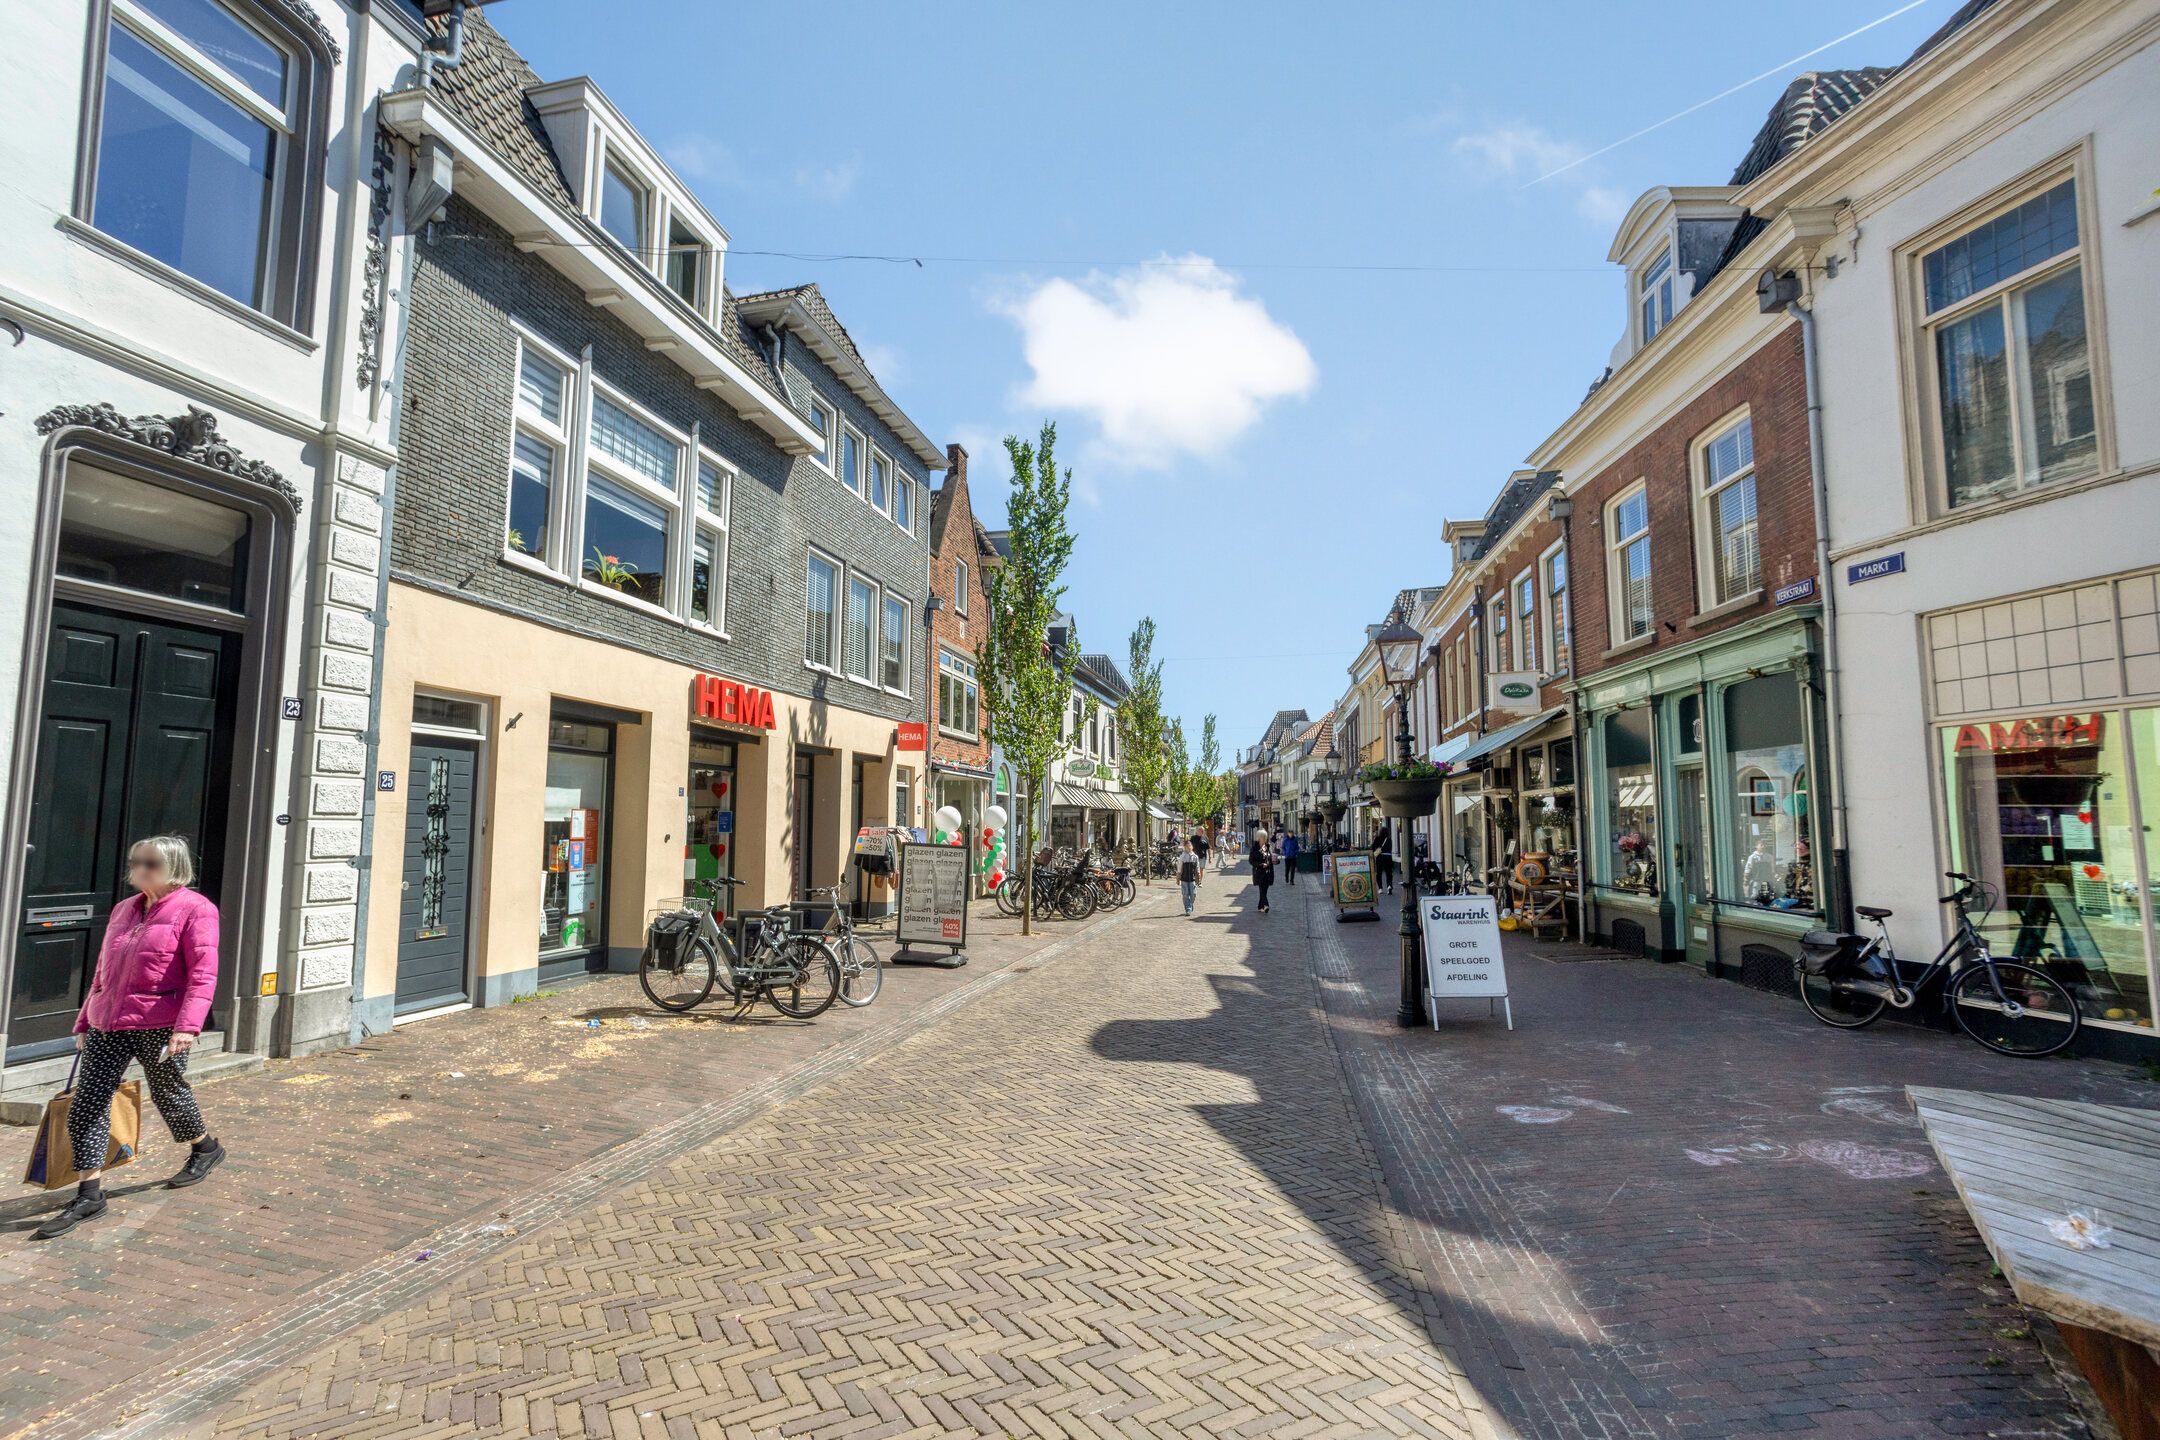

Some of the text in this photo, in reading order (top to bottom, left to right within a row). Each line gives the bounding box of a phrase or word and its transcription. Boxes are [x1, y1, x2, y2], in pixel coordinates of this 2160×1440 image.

[1858, 560, 1890, 578] MARKT
[1776, 583, 1810, 601] KERKSTRAAT
[286, 700, 301, 716] 23
[695, 674, 777, 730] HEMA
[898, 732, 923, 741] HEMA
[381, 774, 394, 788] 25
[907, 848, 964, 858] glazen glazen
[903, 914, 931, 922] glazen
[1430, 905, 1489, 920] Staarink
[1440, 957, 1491, 965] SPEELGOED
[1446, 973, 1488, 981] AFDELING
